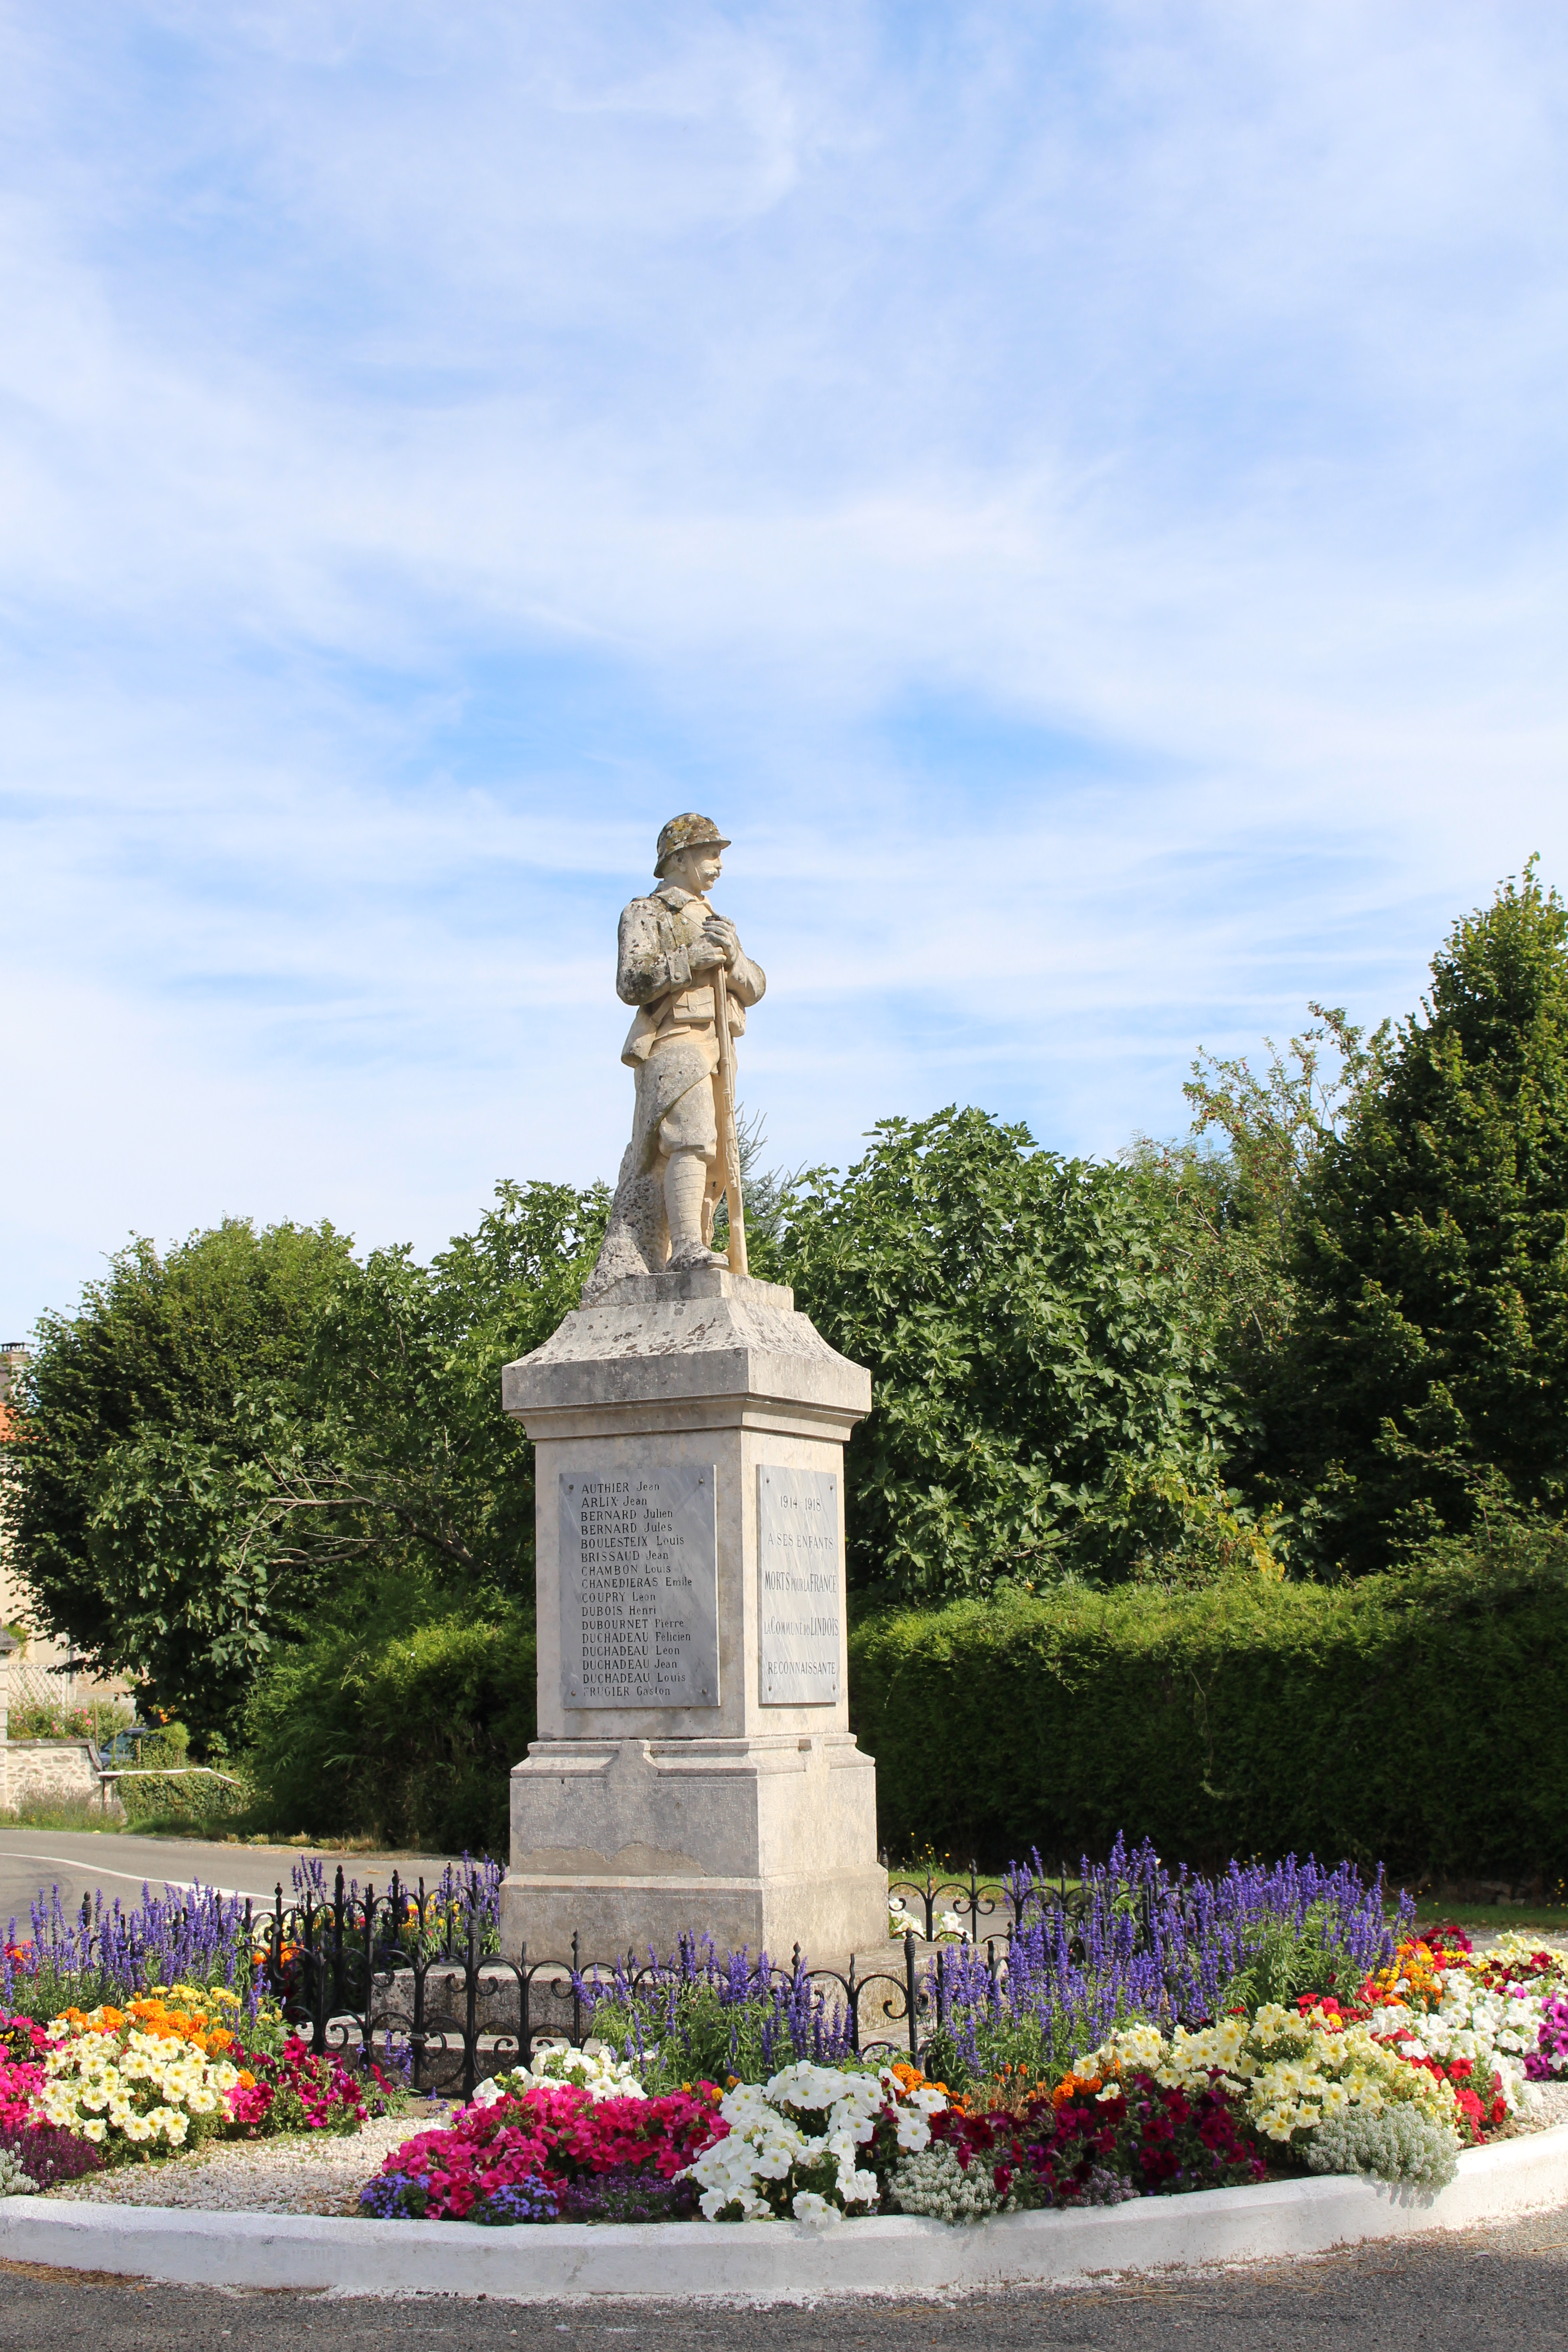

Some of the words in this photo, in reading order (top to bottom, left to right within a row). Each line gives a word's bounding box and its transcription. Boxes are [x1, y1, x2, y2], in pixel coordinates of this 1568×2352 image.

[581, 1482, 629, 1494] AUTHIER
[637, 1481, 660, 1492] Jean
[581, 1496, 617, 1508] ARLIX
[623, 1496, 647, 1506] Jean
[581, 1509, 636, 1521] BERNARD
[643, 1509, 673, 1519] Julien
[581, 1523, 637, 1535] BERNARD
[644, 1522, 672, 1533] Jules
[581, 1536, 648, 1549] BOULESTEIX
[656, 1535, 684, 1546] Louis
[768, 1533, 774, 1545] A
[777, 1533, 793, 1546] SES
[797, 1535, 833, 1550] ENFANTS
[581, 1551, 640, 1563] BRISSAUD
[646, 1550, 669, 1560] Jean
[581, 1564, 637, 1576] CHAMBON
[645, 1564, 671, 1574] Louis
[582, 1577, 658, 1589] CHANEDIERAS
[666, 1577, 692, 1587] Emile
[764, 1571, 790, 1590] MORTS
[791, 1578, 803, 1592] POUR
[804, 1578, 810, 1592] LA
[810, 1573, 837, 1593] FRANCE
[582, 1592, 626, 1603] COUPRY
[582, 1606, 623, 1617] DUBOIS
[629, 1605, 657, 1615] Henri
[582, 1619, 648, 1630] DUBOURNET
[655, 1619, 684, 1628] Pierre
[764, 1622, 771, 1634] LA
[810, 1617, 838, 1636] LINDOIS
[582, 1632, 648, 1644] DUCHADEAU
[655, 1632, 691, 1642] Félicien
[582, 1646, 648, 1656] DUCHADEAU
[656, 1645, 680, 1655] Léon
[582, 1659, 650, 1670] DUCHADEAU
[654, 1659, 677, 1669] Jean
[768, 1661, 836, 1675] RECONNAISSANTE
[583, 1673, 650, 1684] DUCHADEAU
[657, 1672, 686, 1682] Louis
[583, 1686, 630, 1696] FRUGIER
[637, 1686, 671, 1696] Gaston
